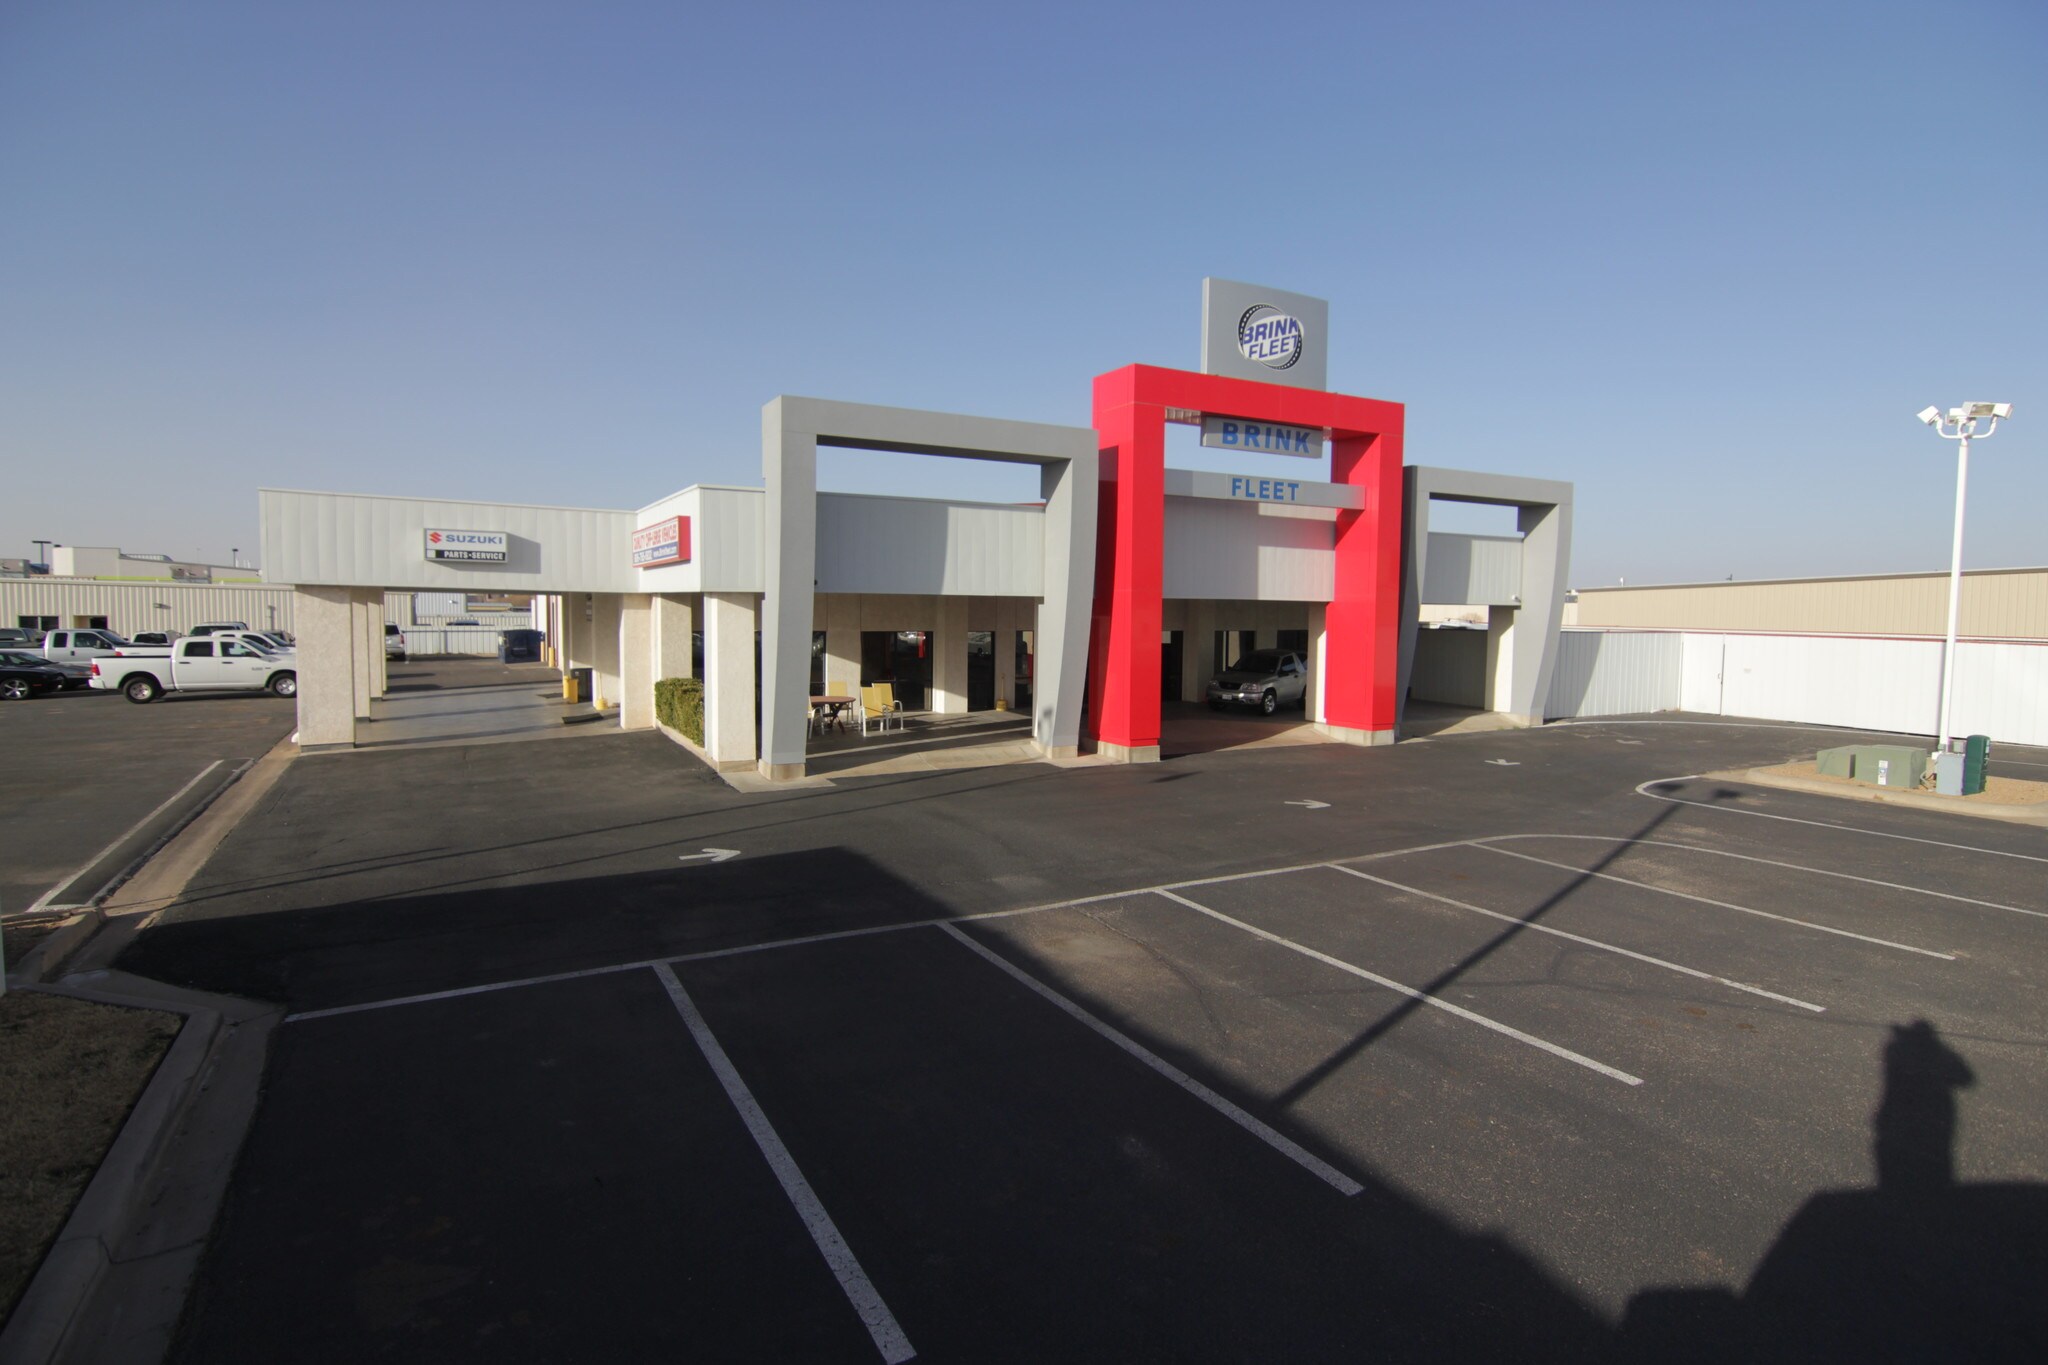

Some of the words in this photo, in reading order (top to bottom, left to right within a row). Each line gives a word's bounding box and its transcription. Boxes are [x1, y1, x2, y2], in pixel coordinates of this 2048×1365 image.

[1243, 317, 1298, 344] BRINK
[1249, 335, 1298, 358] FLEET
[1222, 422, 1310, 454] BRINK
[1232, 477, 1299, 501] FLEET
[446, 534, 502, 544] SUZUKI
